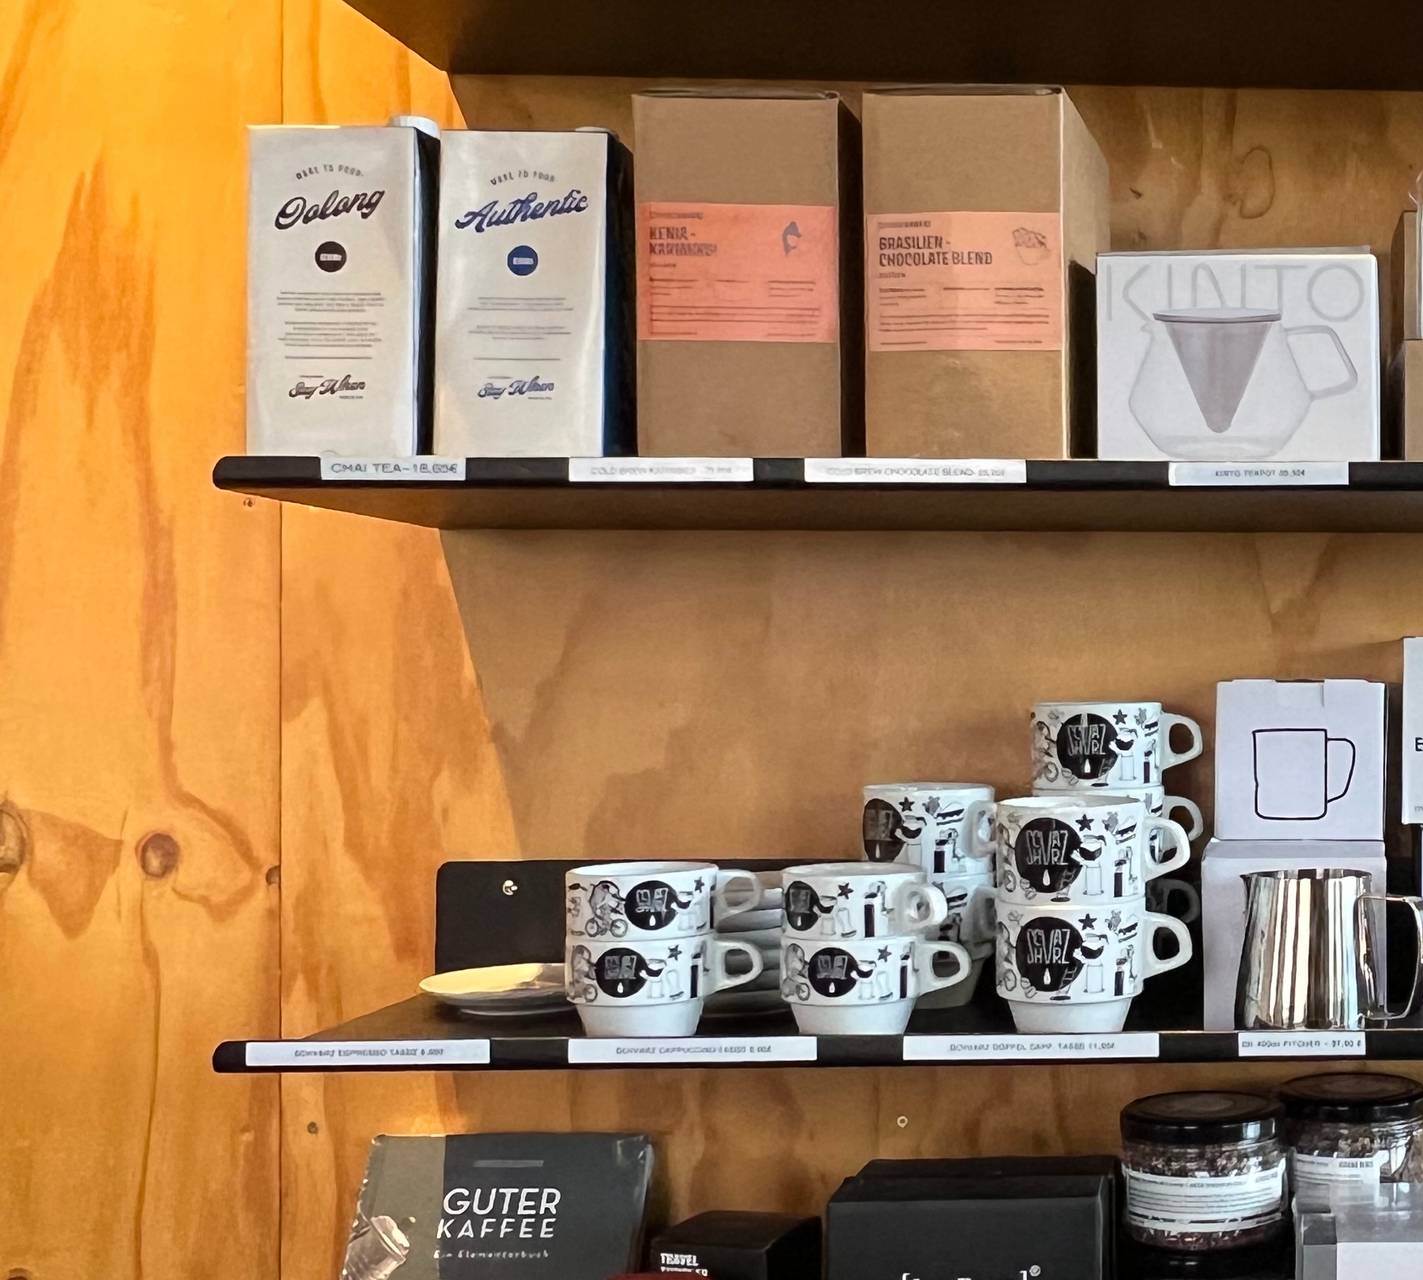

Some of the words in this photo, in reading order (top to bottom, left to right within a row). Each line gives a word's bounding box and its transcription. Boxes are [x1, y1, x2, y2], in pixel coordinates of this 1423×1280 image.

[274, 189, 386, 231] Oolong
[454, 189, 589, 233] Authentic
[879, 235, 943, 250] BRASILIEN
[879, 251, 949, 267] CHOCOLATE
[951, 251, 993, 265] BLEND
[1106, 262, 1366, 323] KINTO
[331, 463, 368, 474] CHAI
[443, 1188, 561, 1215] GUTER
[436, 1218, 557, 1239] KAFFEE
[660, 1252, 699, 1267] TRAVEL
